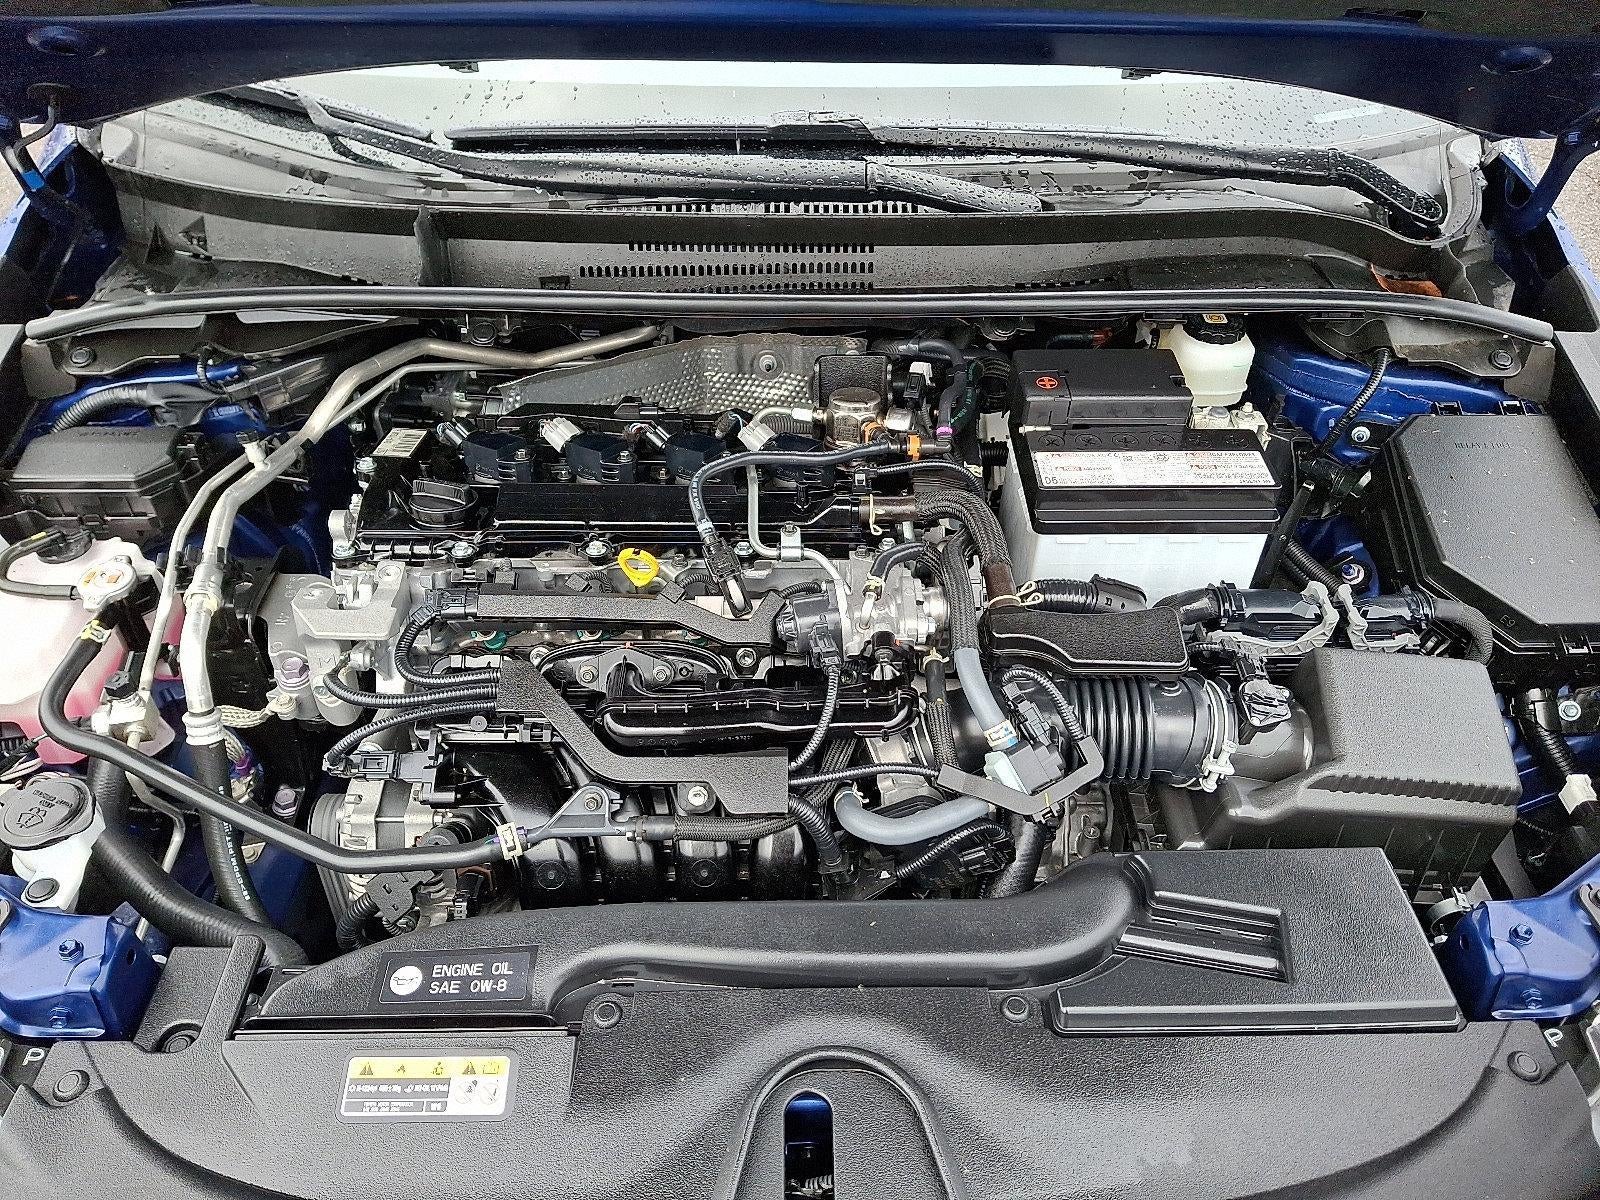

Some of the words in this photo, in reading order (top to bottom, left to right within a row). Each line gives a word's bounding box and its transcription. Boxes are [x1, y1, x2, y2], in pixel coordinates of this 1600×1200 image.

[431, 963, 484, 978] ENGINE
[491, 961, 514, 975] OIL
[429, 980, 461, 994] SAE
[470, 979, 508, 993] 0W-8
[1543, 1028, 1563, 1048] P
[22, 1047, 44, 1066] P
